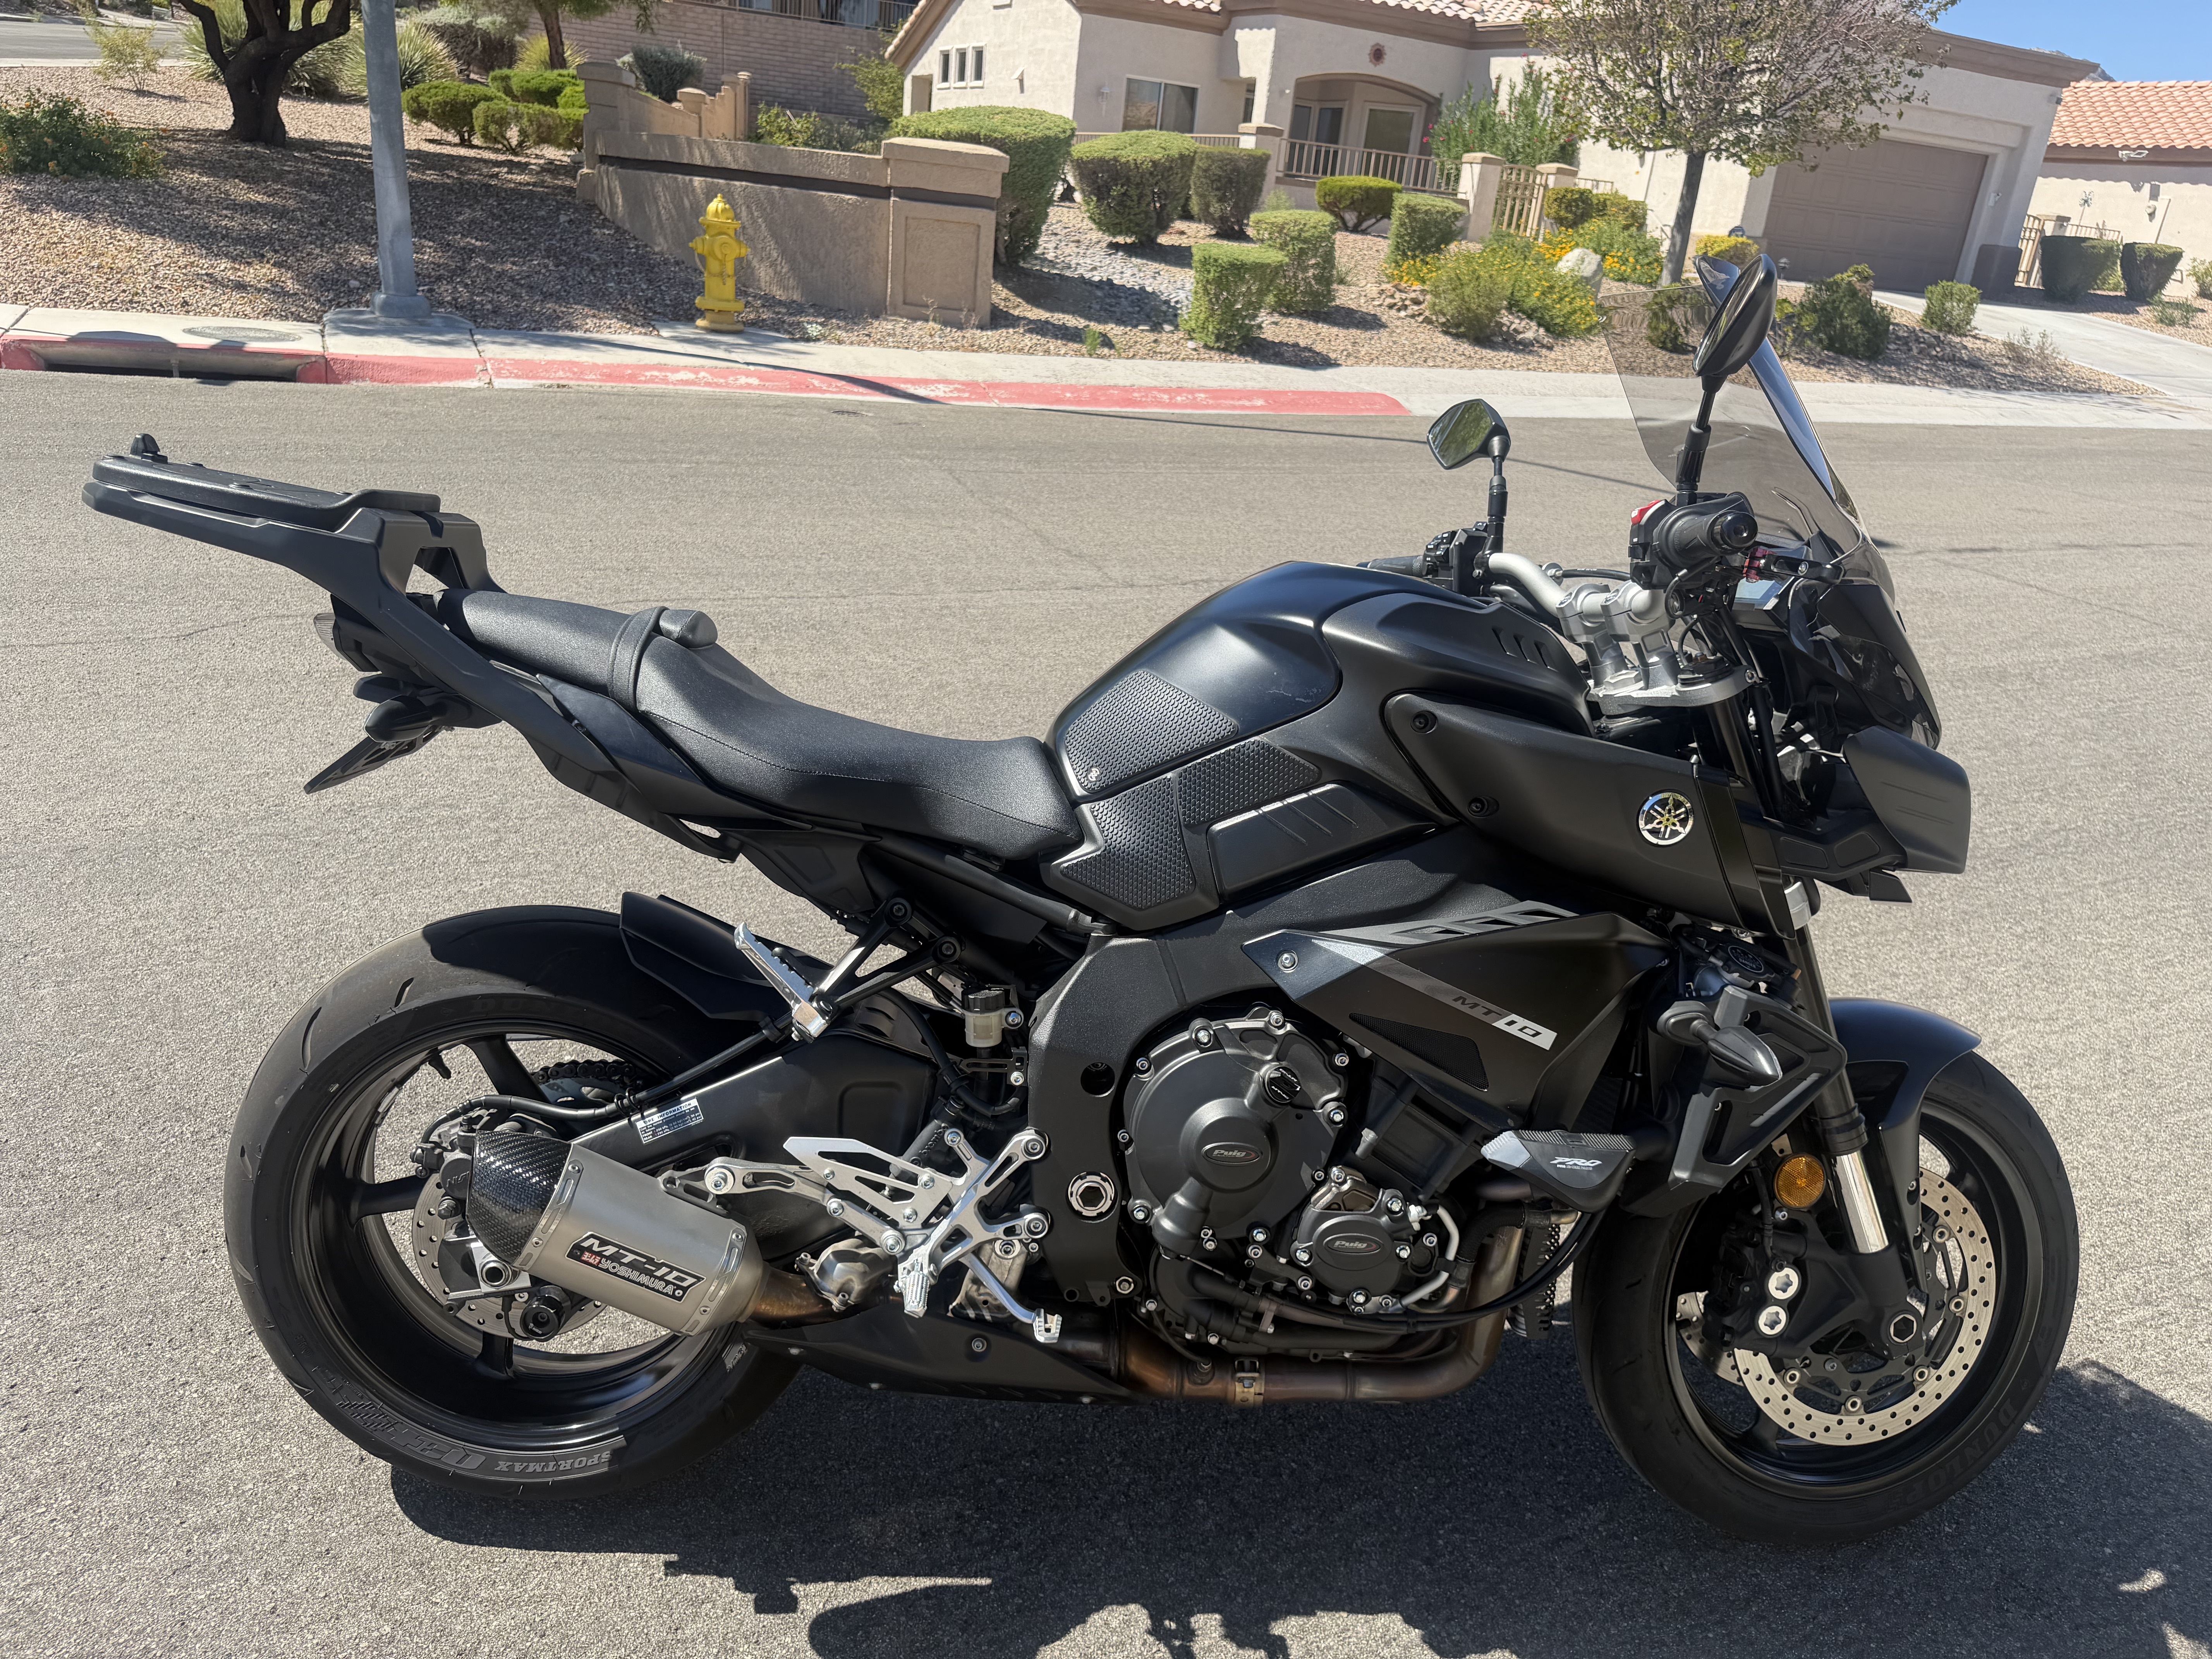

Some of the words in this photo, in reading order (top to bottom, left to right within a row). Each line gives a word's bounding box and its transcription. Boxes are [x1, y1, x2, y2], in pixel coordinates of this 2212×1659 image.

[657, 1102, 692, 1119] INFORMATION
[1550, 1156, 1602, 1166] PRO
[580, 1238, 697, 1287] MT-10
[598, 1258, 674, 1295] YOSHIMURA
[494, 1451, 611, 1472] SPORTMAX
[1903, 1397, 2017, 1505] DUNLOP
